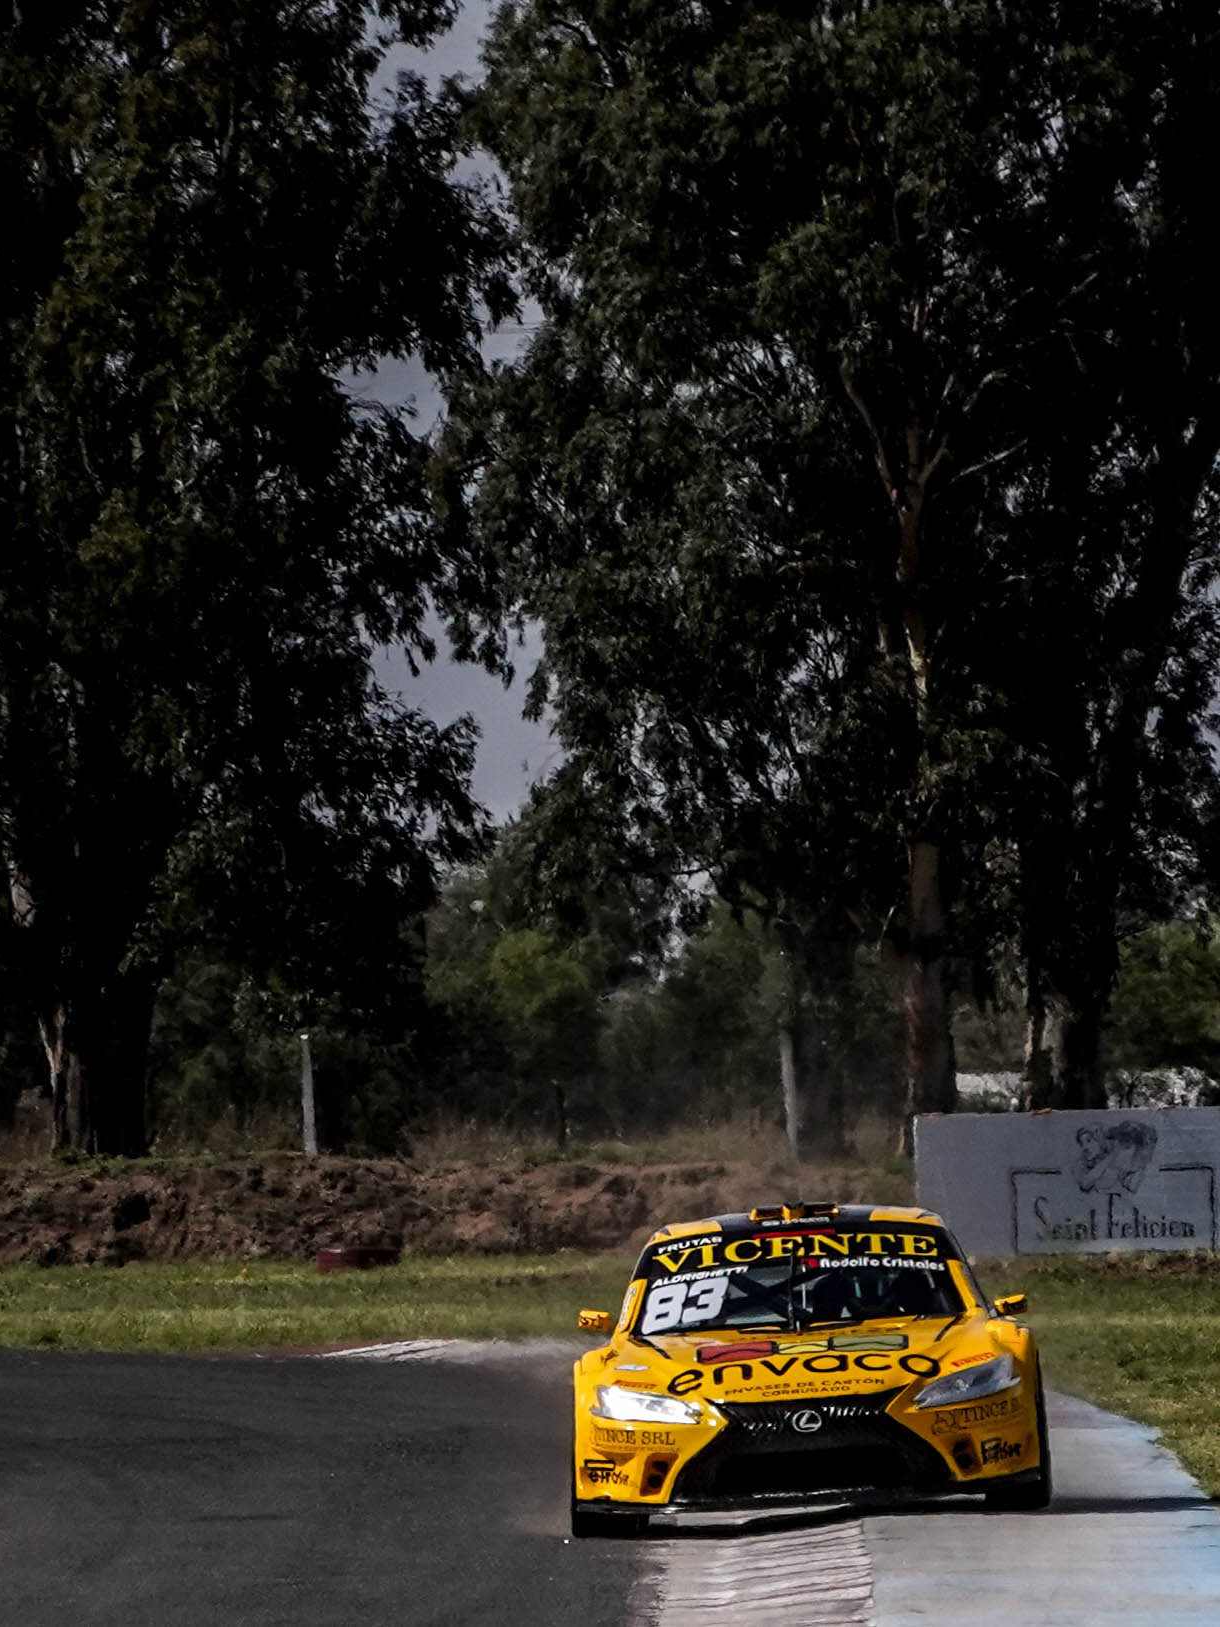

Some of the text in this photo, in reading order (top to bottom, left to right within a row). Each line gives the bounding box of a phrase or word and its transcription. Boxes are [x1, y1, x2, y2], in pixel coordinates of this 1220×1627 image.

[652, 1233, 938, 1273] VICENTE
[657, 1236, 723, 1254] FRUTAS
[882, 1257, 945, 1272] Cristales
[651, 1265, 750, 1289] ALDRIGHETTI
[641, 1276, 729, 1335] 83
[667, 1353, 941, 1397] envaco
[724, 1382, 791, 1396] ENVASES
[641, 1431, 676, 1446] SRL
